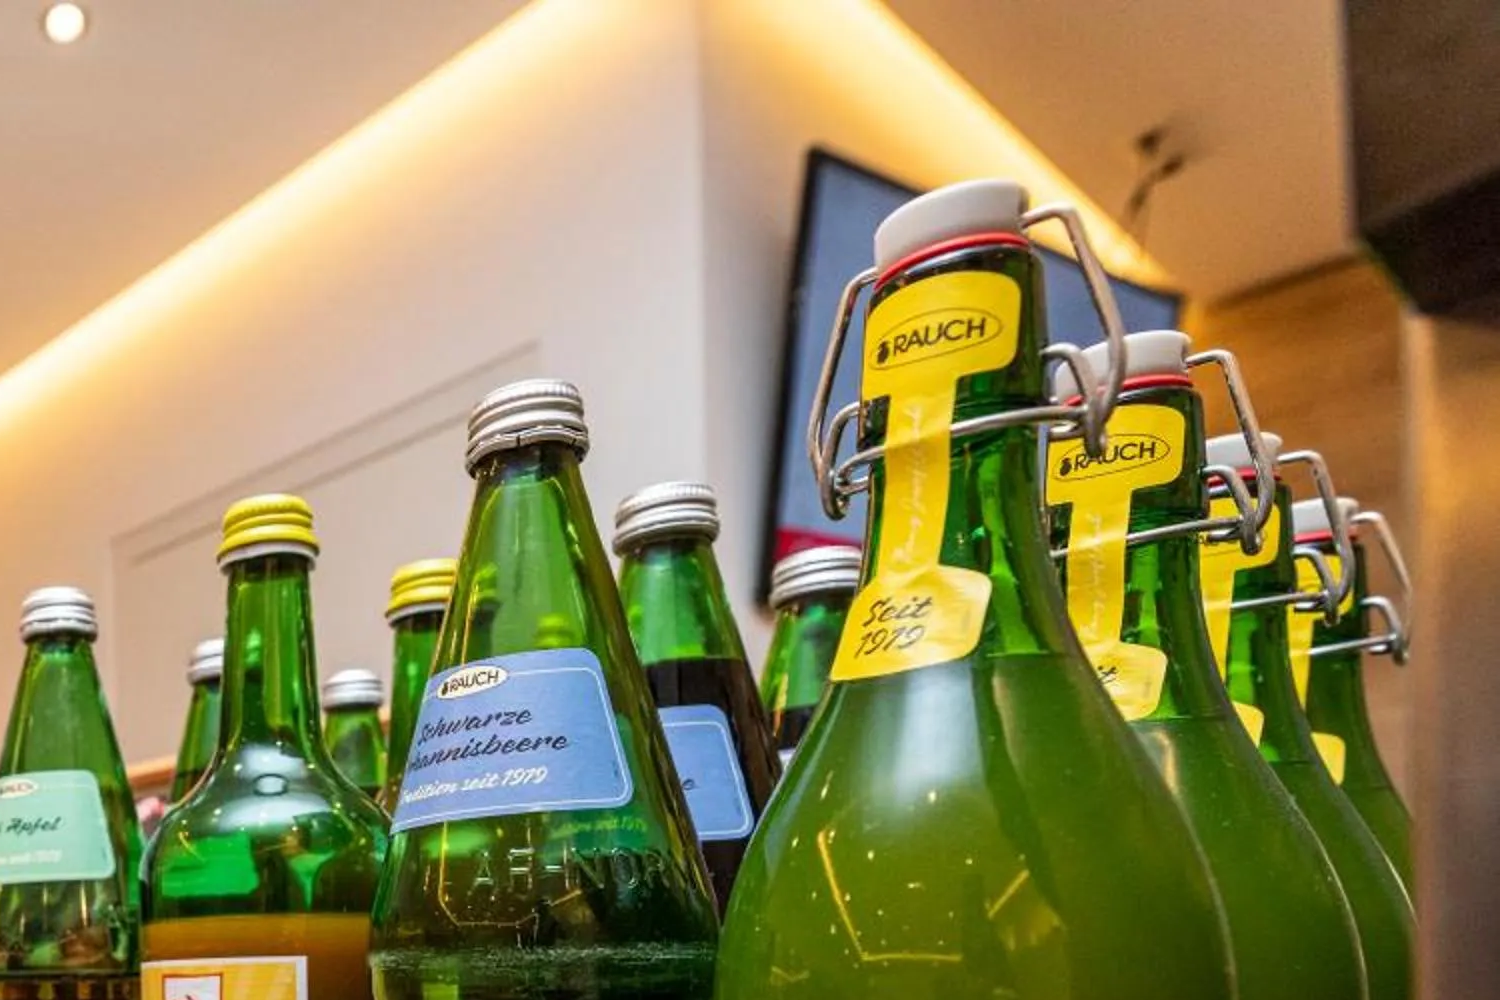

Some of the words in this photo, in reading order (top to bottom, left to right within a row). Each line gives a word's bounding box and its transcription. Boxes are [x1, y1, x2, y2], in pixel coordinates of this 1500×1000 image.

[892, 316, 987, 357] RAUCH
[1074, 441, 1157, 470] RUCH
[861, 596, 933, 628] Seit
[449, 670, 500, 692] RAUCH
[417, 708, 533, 747] Schwarze
